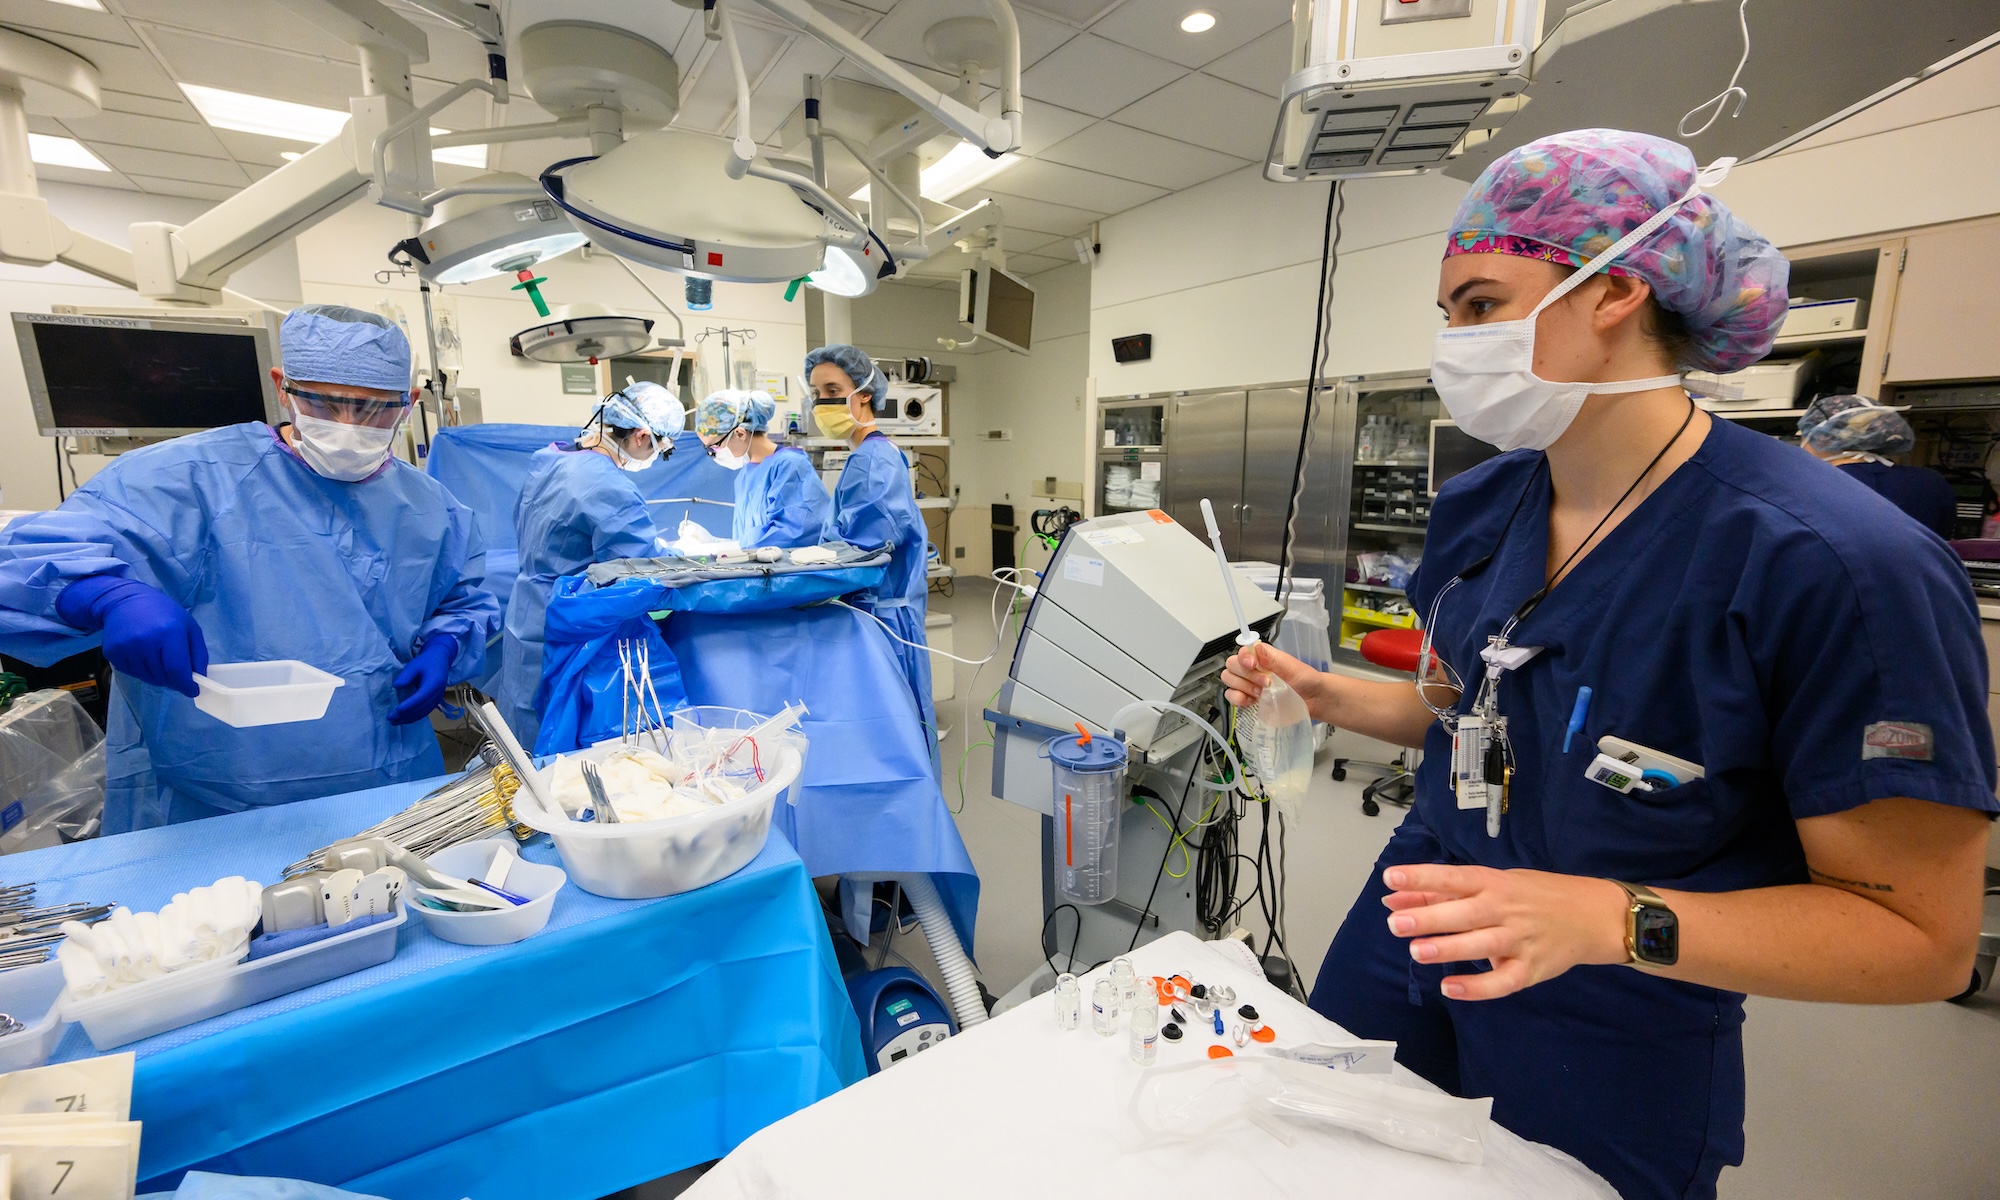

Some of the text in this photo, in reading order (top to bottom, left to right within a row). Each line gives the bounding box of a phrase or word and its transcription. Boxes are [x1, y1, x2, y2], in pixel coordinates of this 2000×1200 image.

[26, 314, 141, 328] COMPOSITE ENDOEYE
[50, 1160, 75, 1196] 7
